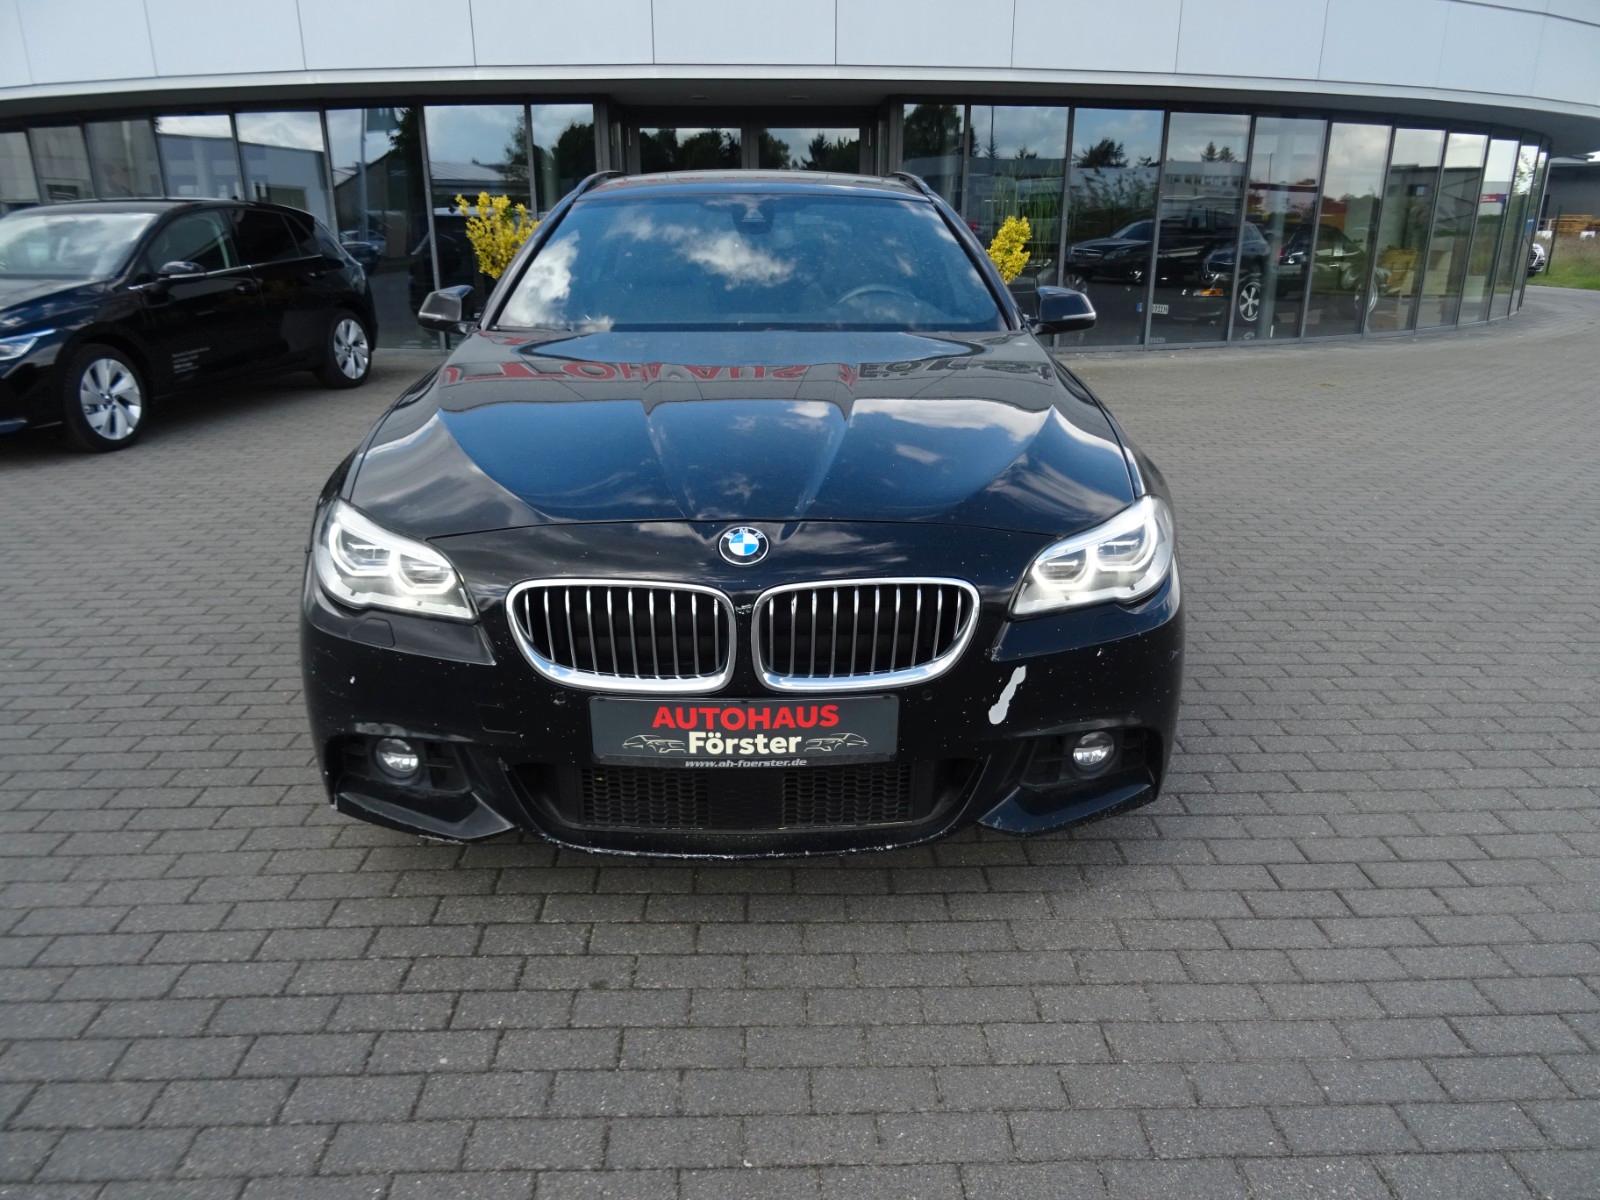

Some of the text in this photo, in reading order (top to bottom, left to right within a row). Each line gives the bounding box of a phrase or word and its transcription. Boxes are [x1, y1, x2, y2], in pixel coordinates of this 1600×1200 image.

[652, 704, 840, 731] AUTOHAUS
[688, 731, 802, 755] Förster
[684, 758, 808, 768] www.ah-foerster.de
